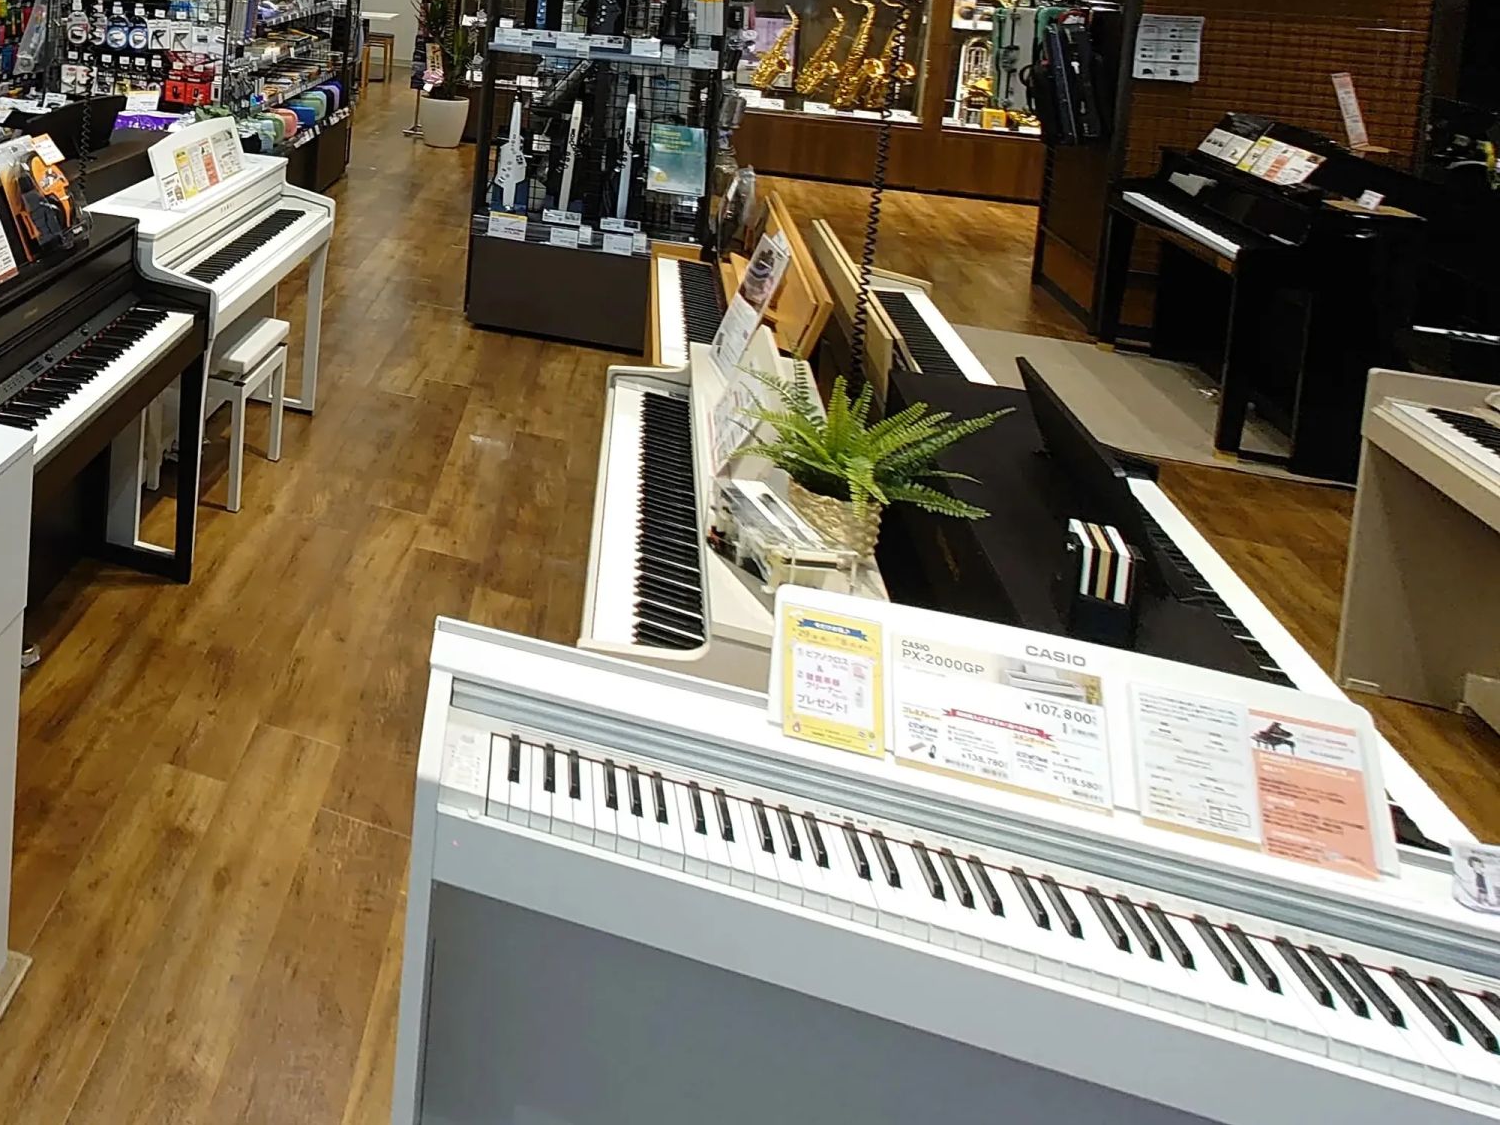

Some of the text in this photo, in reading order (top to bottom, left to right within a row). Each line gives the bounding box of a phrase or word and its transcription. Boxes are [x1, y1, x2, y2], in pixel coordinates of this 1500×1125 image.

[901, 640, 930, 651] CASIO
[1025, 645, 1086, 667] CASIO
[903, 649, 985, 675] PX-2000GP
